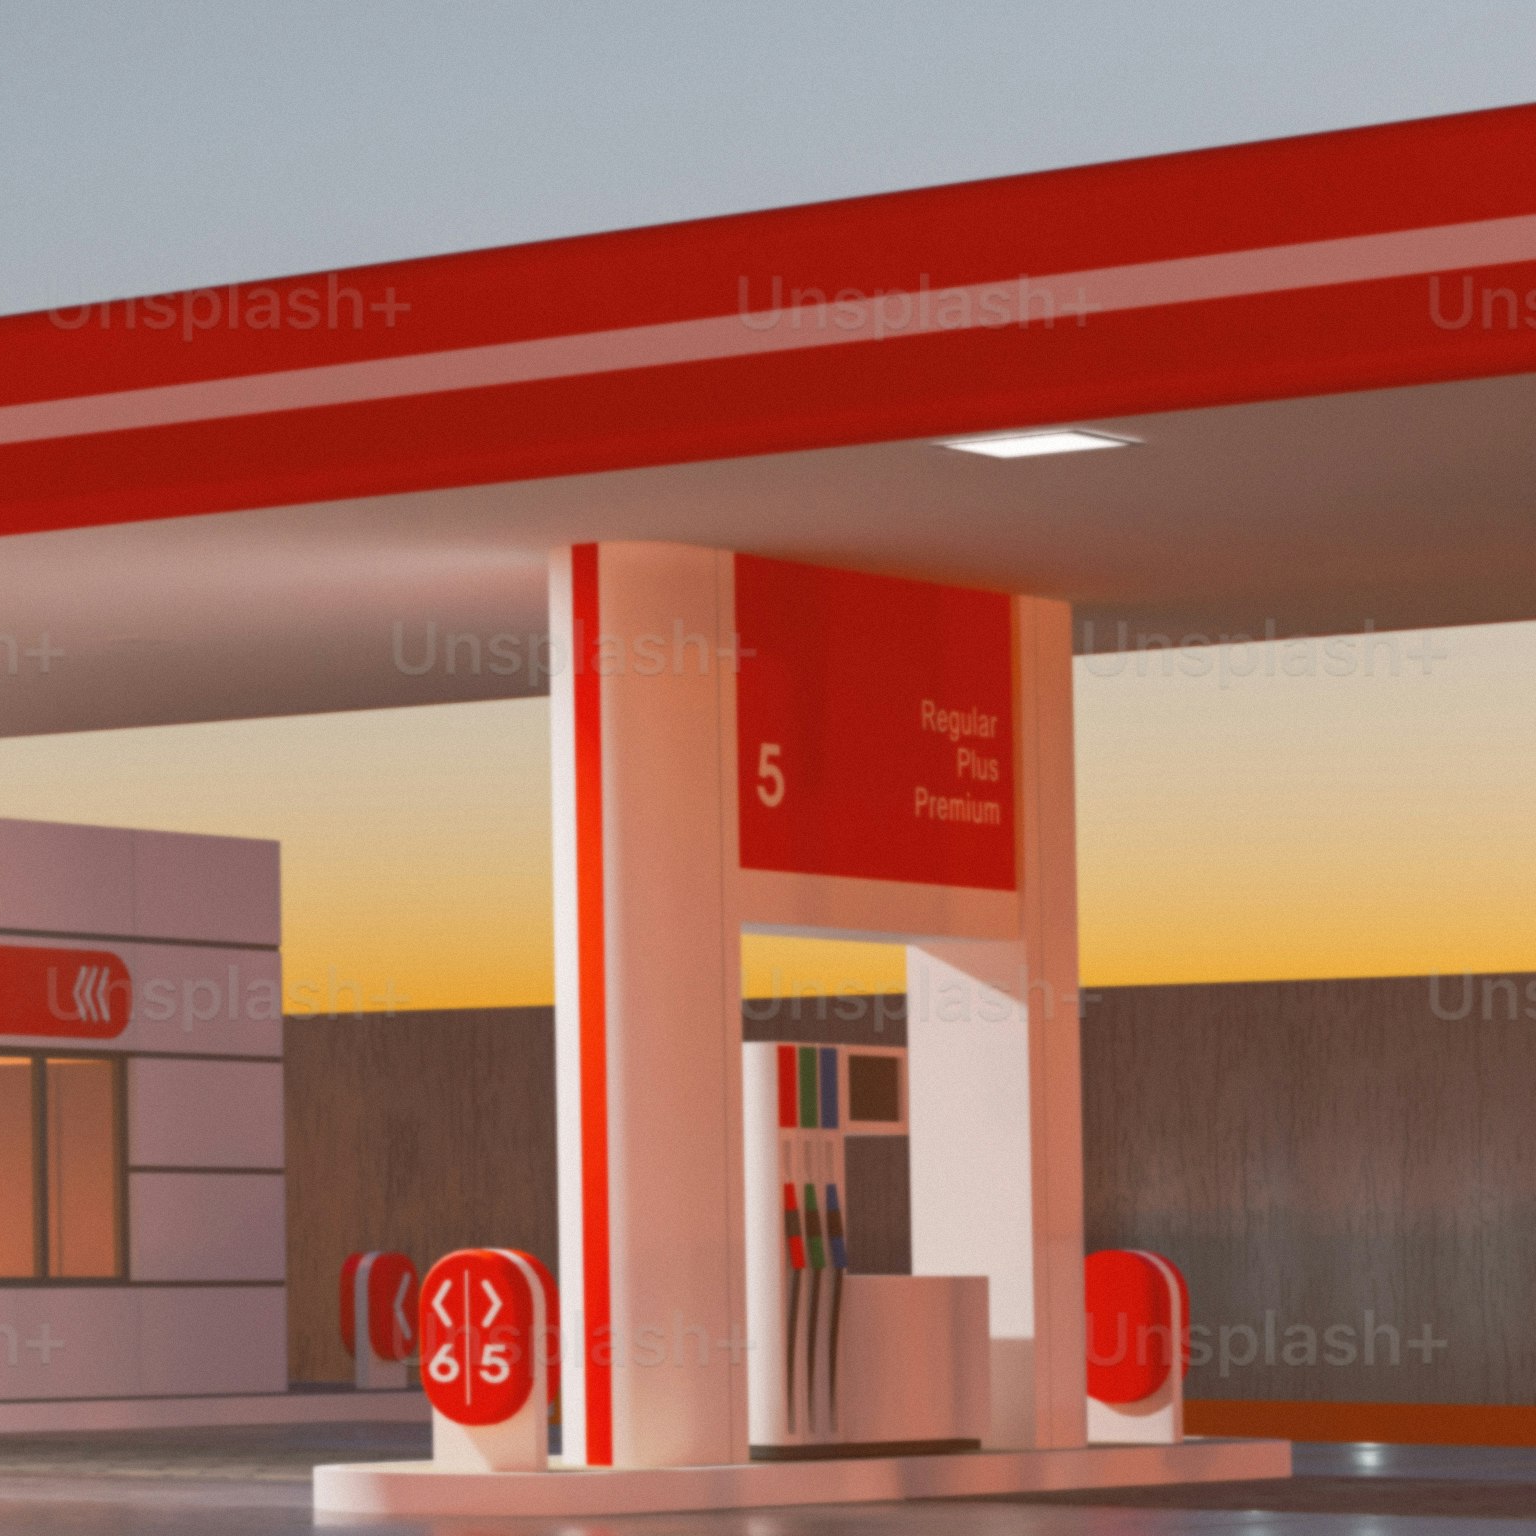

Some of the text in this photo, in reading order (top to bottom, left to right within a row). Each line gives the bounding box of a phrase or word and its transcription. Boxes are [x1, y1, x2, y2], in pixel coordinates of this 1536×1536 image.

[921, 699, 997, 742] Regular
[756, 743, 785, 808] 5
[957, 747, 998, 781] Plus
[915, 786, 1000, 825] Premium
[428, 1343, 460, 1383] 6
[479, 1344, 510, 1384] 5
